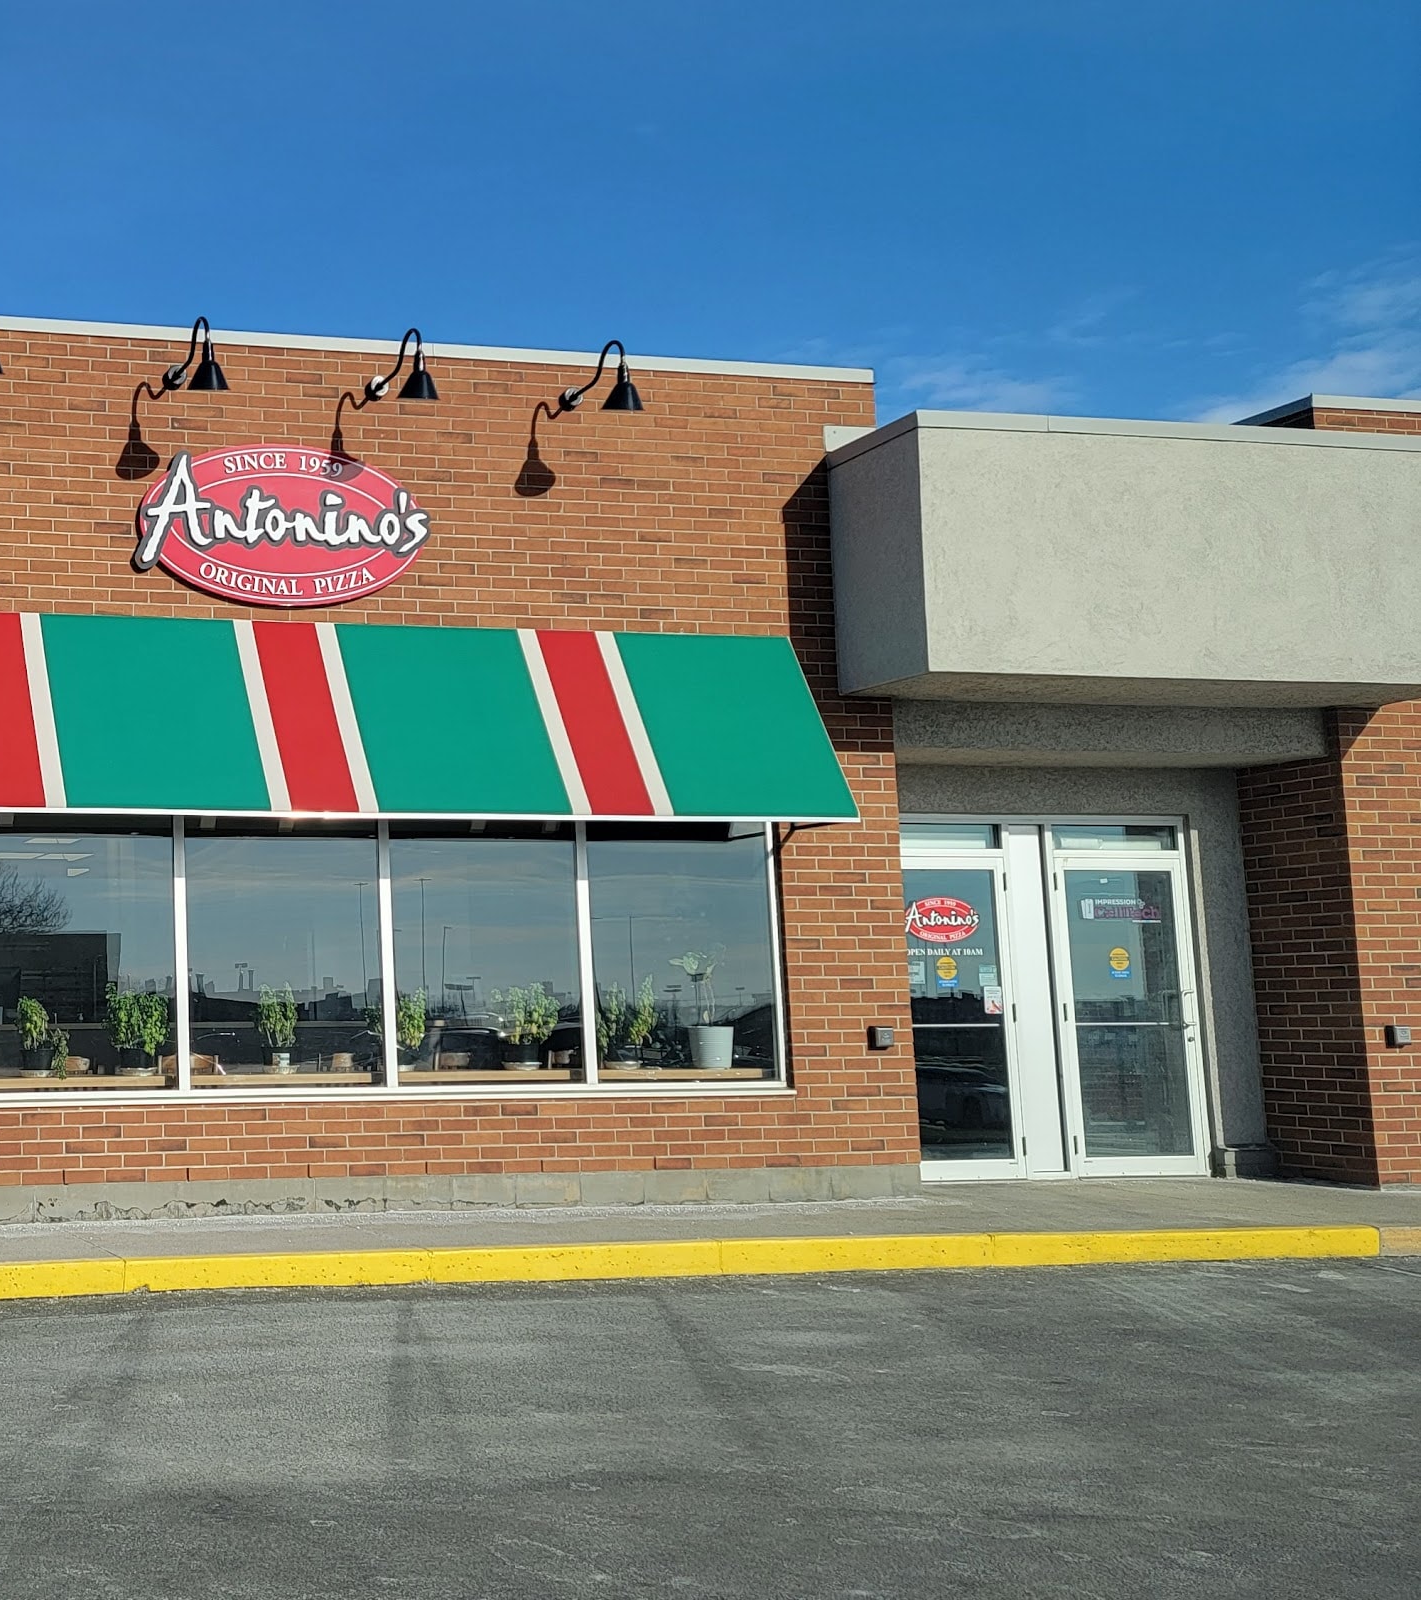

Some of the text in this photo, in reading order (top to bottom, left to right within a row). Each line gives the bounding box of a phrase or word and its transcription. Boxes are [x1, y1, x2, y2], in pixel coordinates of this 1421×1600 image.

[224, 452, 343, 478] SINCE 1959
[139, 453, 429, 564] Antonino's
[198, 562, 376, 596] ORIGINAL PIZZA
[905, 901, 979, 933] Antonino's
[927, 948, 951, 956] DAILY
[951, 948, 961, 956] AT
[963, 948, 983, 956] 10AM
